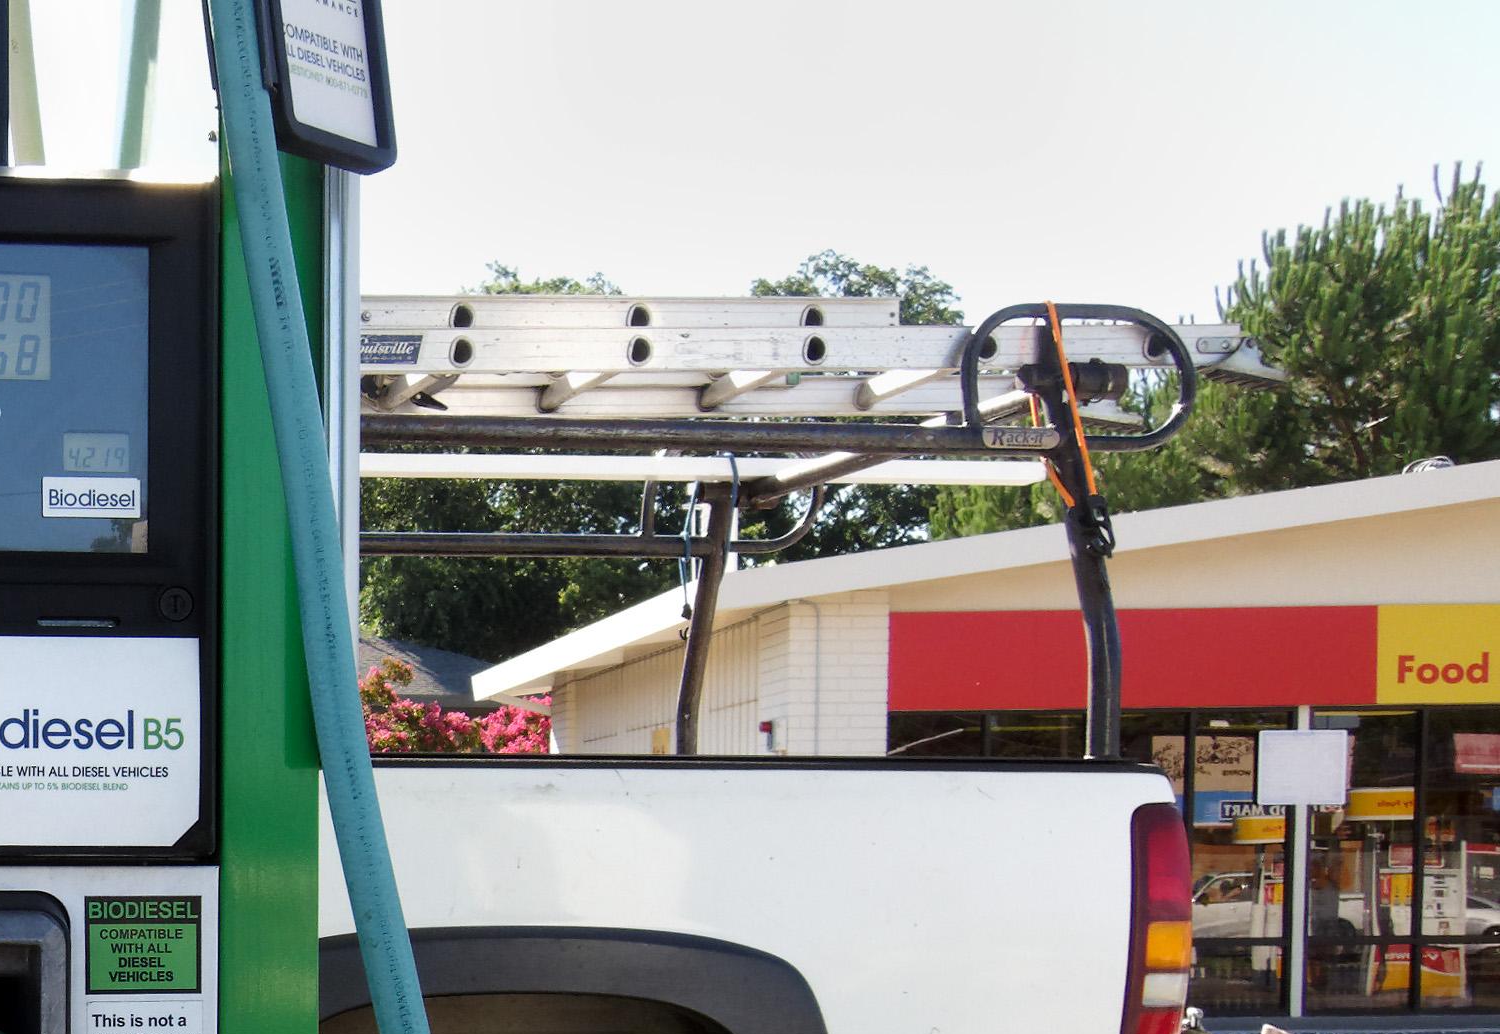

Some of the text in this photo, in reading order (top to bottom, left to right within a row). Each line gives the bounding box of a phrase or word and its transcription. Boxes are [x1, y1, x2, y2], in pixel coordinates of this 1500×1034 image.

[340, 42, 364, 64] WITH
[286, 42, 367, 82] LL DIESEL VEHICLES
[48, 487, 136, 508] Biodiesel
[1397, 651, 1490, 684] Food
[143, 717, 185, 751] B5
[16, 765, 46, 777] WITH
[48, 766, 69, 778] ALL
[72, 766, 110, 778] DIESEL
[112, 766, 169, 778] VEHICLES
[22, 782, 33, 791] UP
[34, 782, 45, 791] TO
[47, 782, 59, 791] 5%
[61, 782, 101, 791] BIODIESEL
[102, 783, 129, 792] BLEND
[88, 901, 199, 920] BIODIESEL
[99, 928, 184, 940] COMPATIBLE
[110, 943, 172, 954] WITH ALL
[118, 957, 166, 968] DIESEL
[109, 971, 174, 983] VEHICLES
[92, 1014, 187, 1028] This is not a
